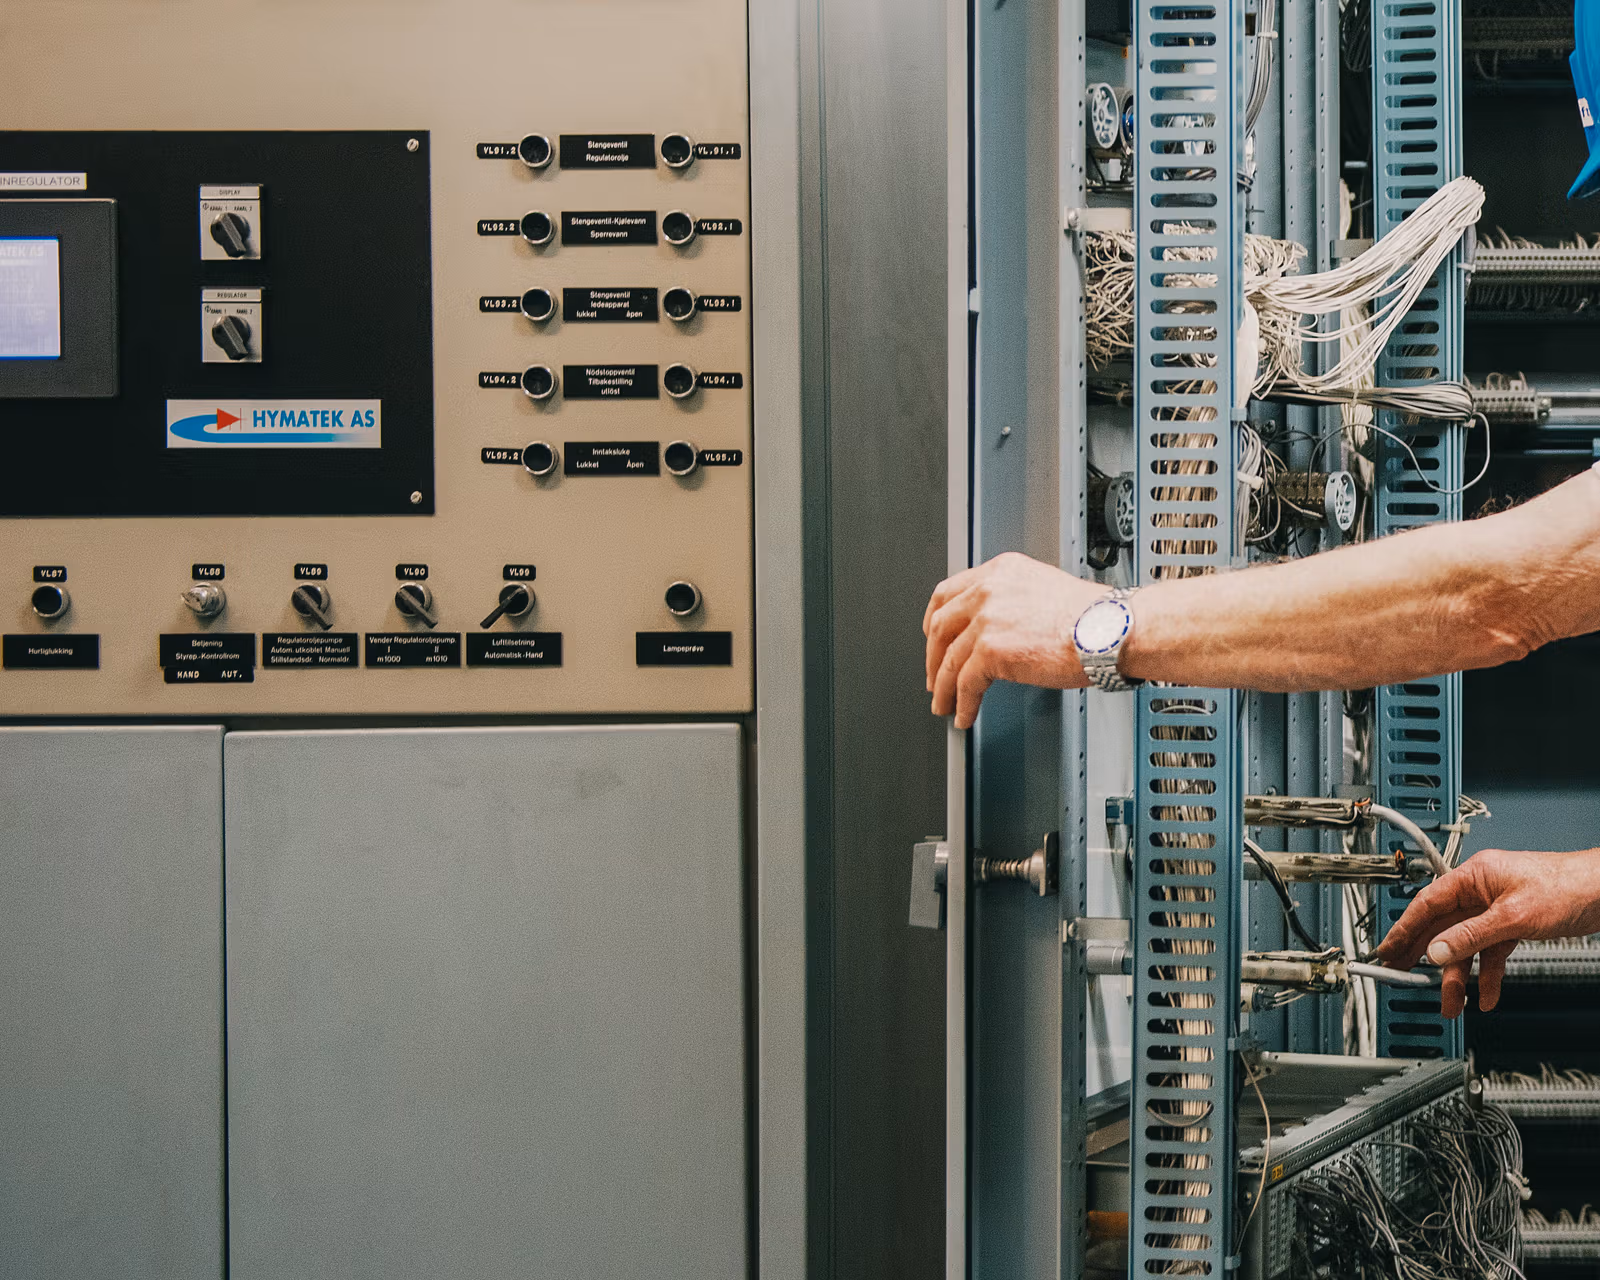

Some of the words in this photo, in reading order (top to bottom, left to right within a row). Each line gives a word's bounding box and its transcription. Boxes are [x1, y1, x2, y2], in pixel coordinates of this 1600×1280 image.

[587, 140, 628, 150] Stengeventil
[590, 230, 628, 239] Sperrevann
[589, 290, 631, 300] Stengeventil
[587, 377, 634, 386] Tilbakestilling
[252, 410, 344, 428] HYMATEK
[350, 410, 376, 428] AS
[592, 448, 631, 456] Inntaksluke
[576, 460, 600, 469] Lukket
[626, 459, 644, 470] Åpen
[191, 640, 223, 648] Betjening
[277, 636, 343, 645] Regulatoroljepumpe
[369, 636, 393, 644] Vender
[492, 638, 536, 647] Lufttilsetning
[28, 647, 74, 656] Hurtiglukking
[663, 645, 704, 653] Lampeprøve
[176, 670, 200, 679] HAND
